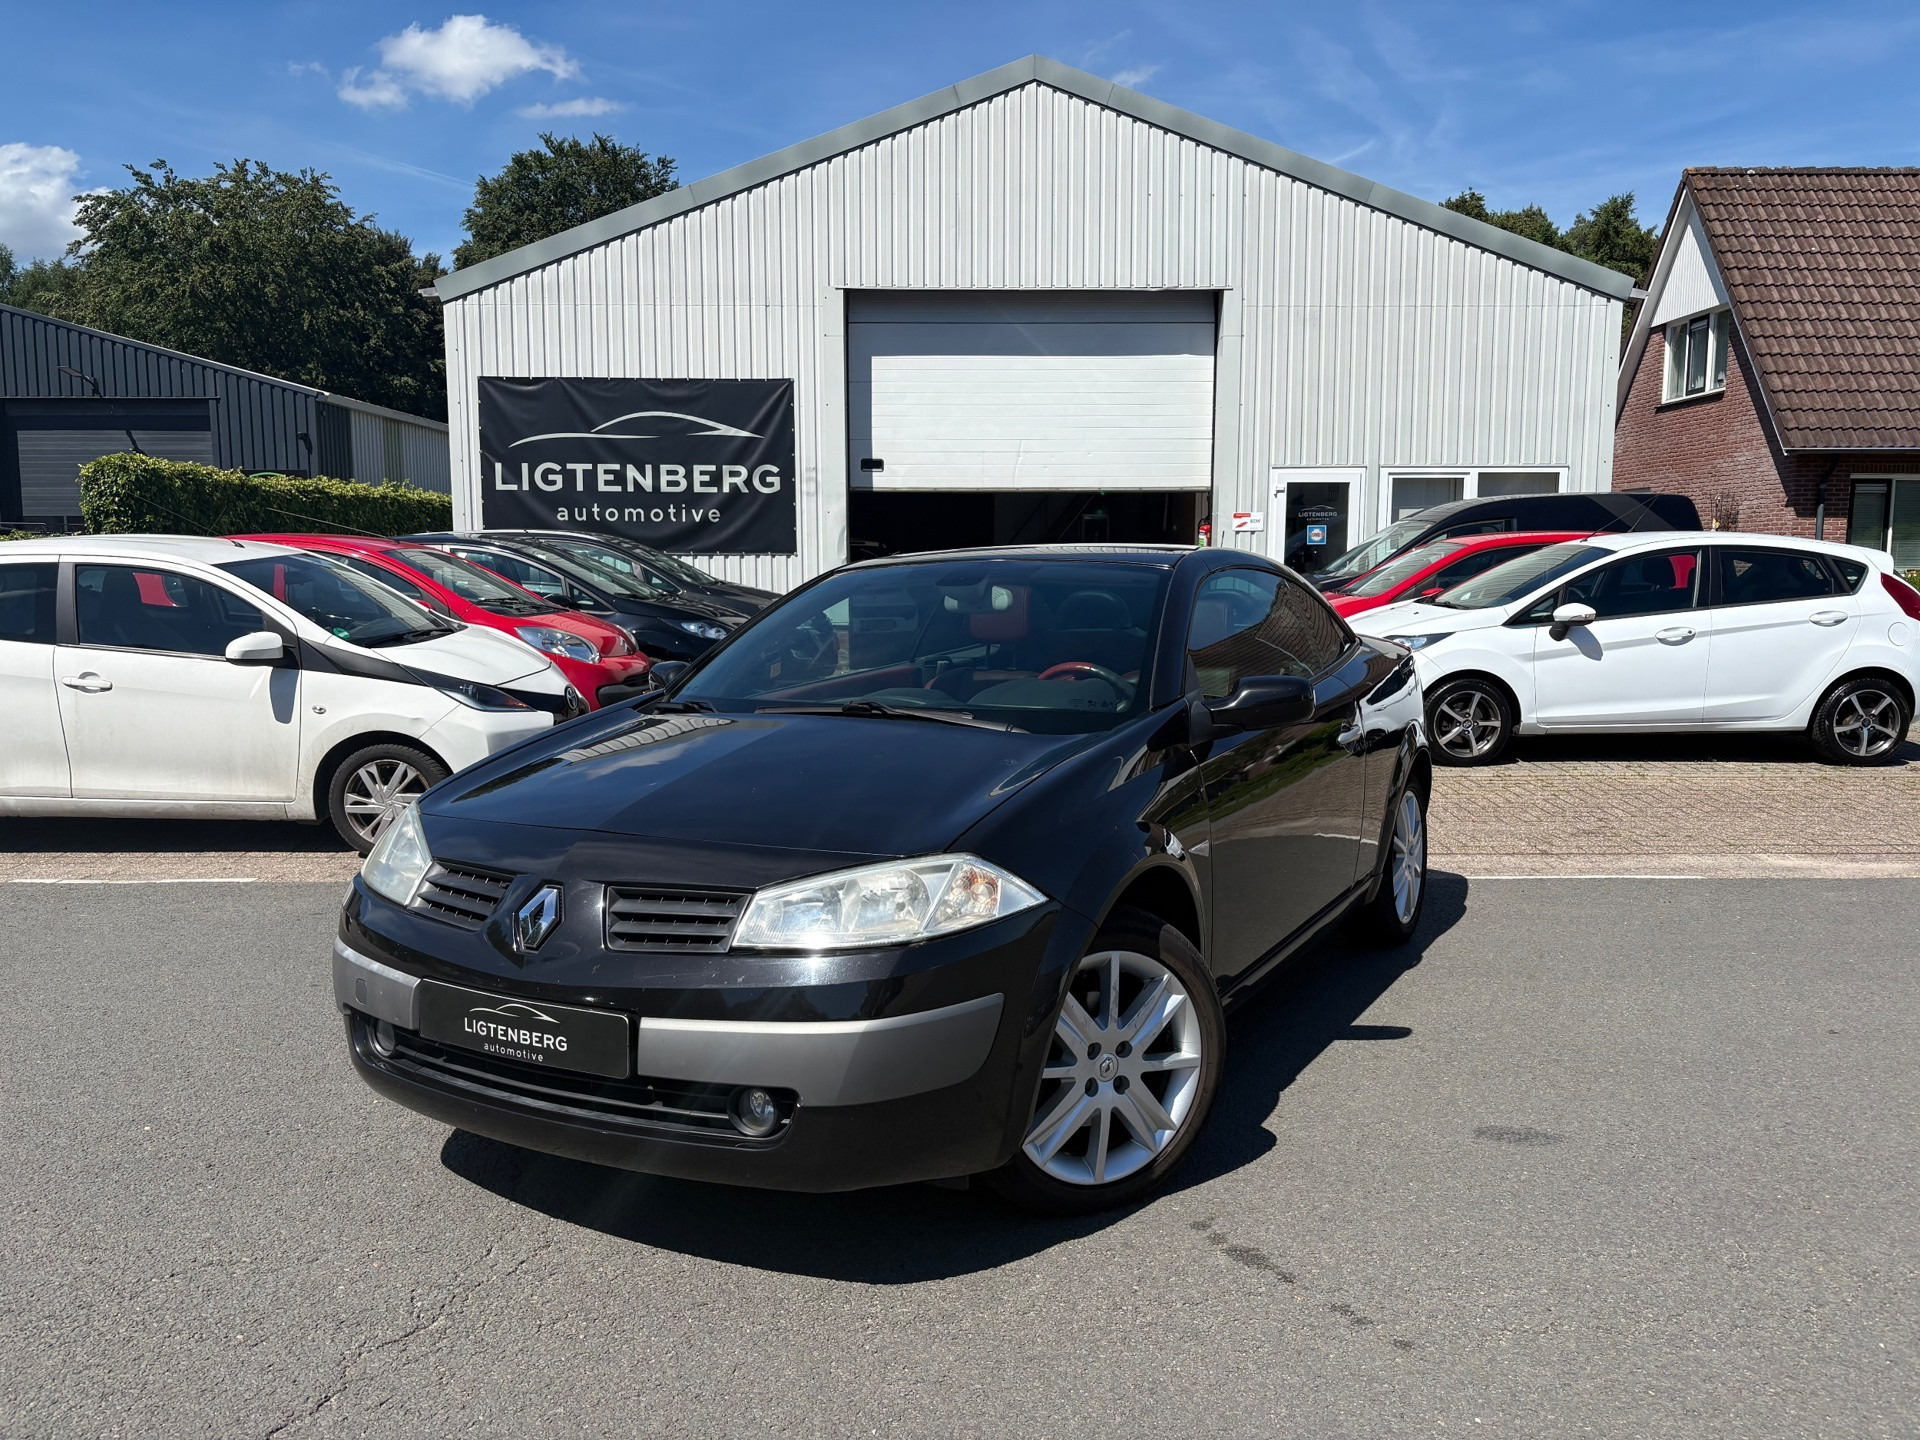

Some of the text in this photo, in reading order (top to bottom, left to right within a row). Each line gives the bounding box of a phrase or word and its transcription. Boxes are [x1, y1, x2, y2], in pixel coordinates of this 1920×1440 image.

[494, 462, 781, 494] LIGTENBERG
[557, 504, 721, 523] automotive
[464, 1017, 568, 1051] LIGTENBERG
[484, 1042, 544, 1062] automotive
